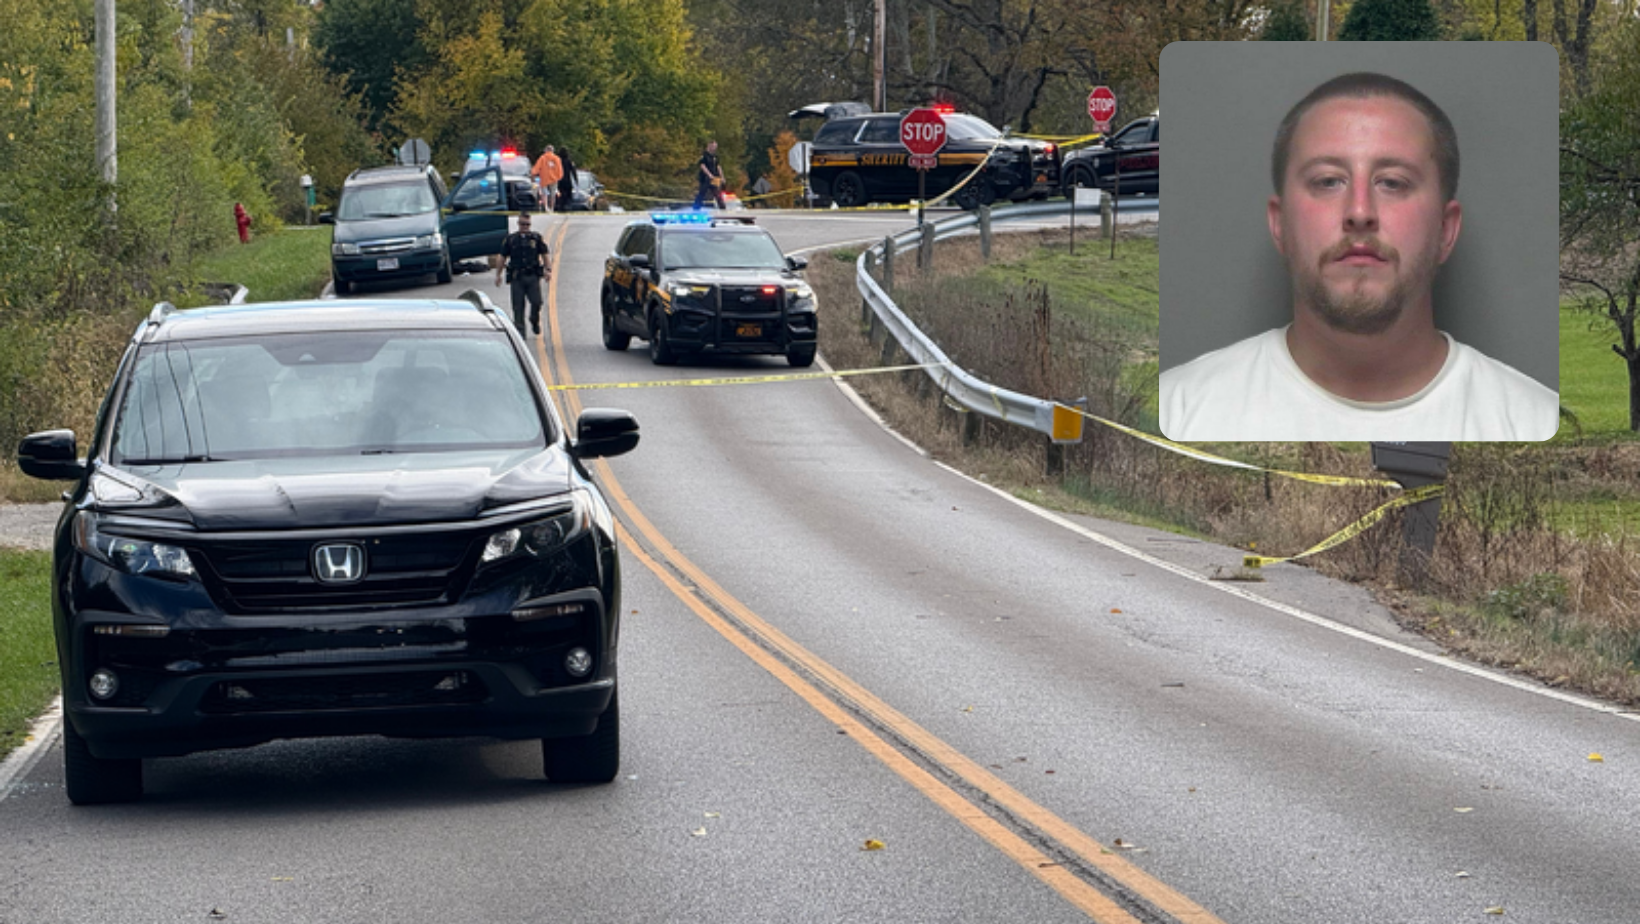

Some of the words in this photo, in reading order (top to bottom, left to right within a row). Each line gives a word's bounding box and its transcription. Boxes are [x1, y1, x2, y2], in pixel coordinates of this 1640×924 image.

[1089, 98, 1114, 112] STOP
[903, 122, 944, 141] STOP
[861, 153, 906, 166] SHERIFF
